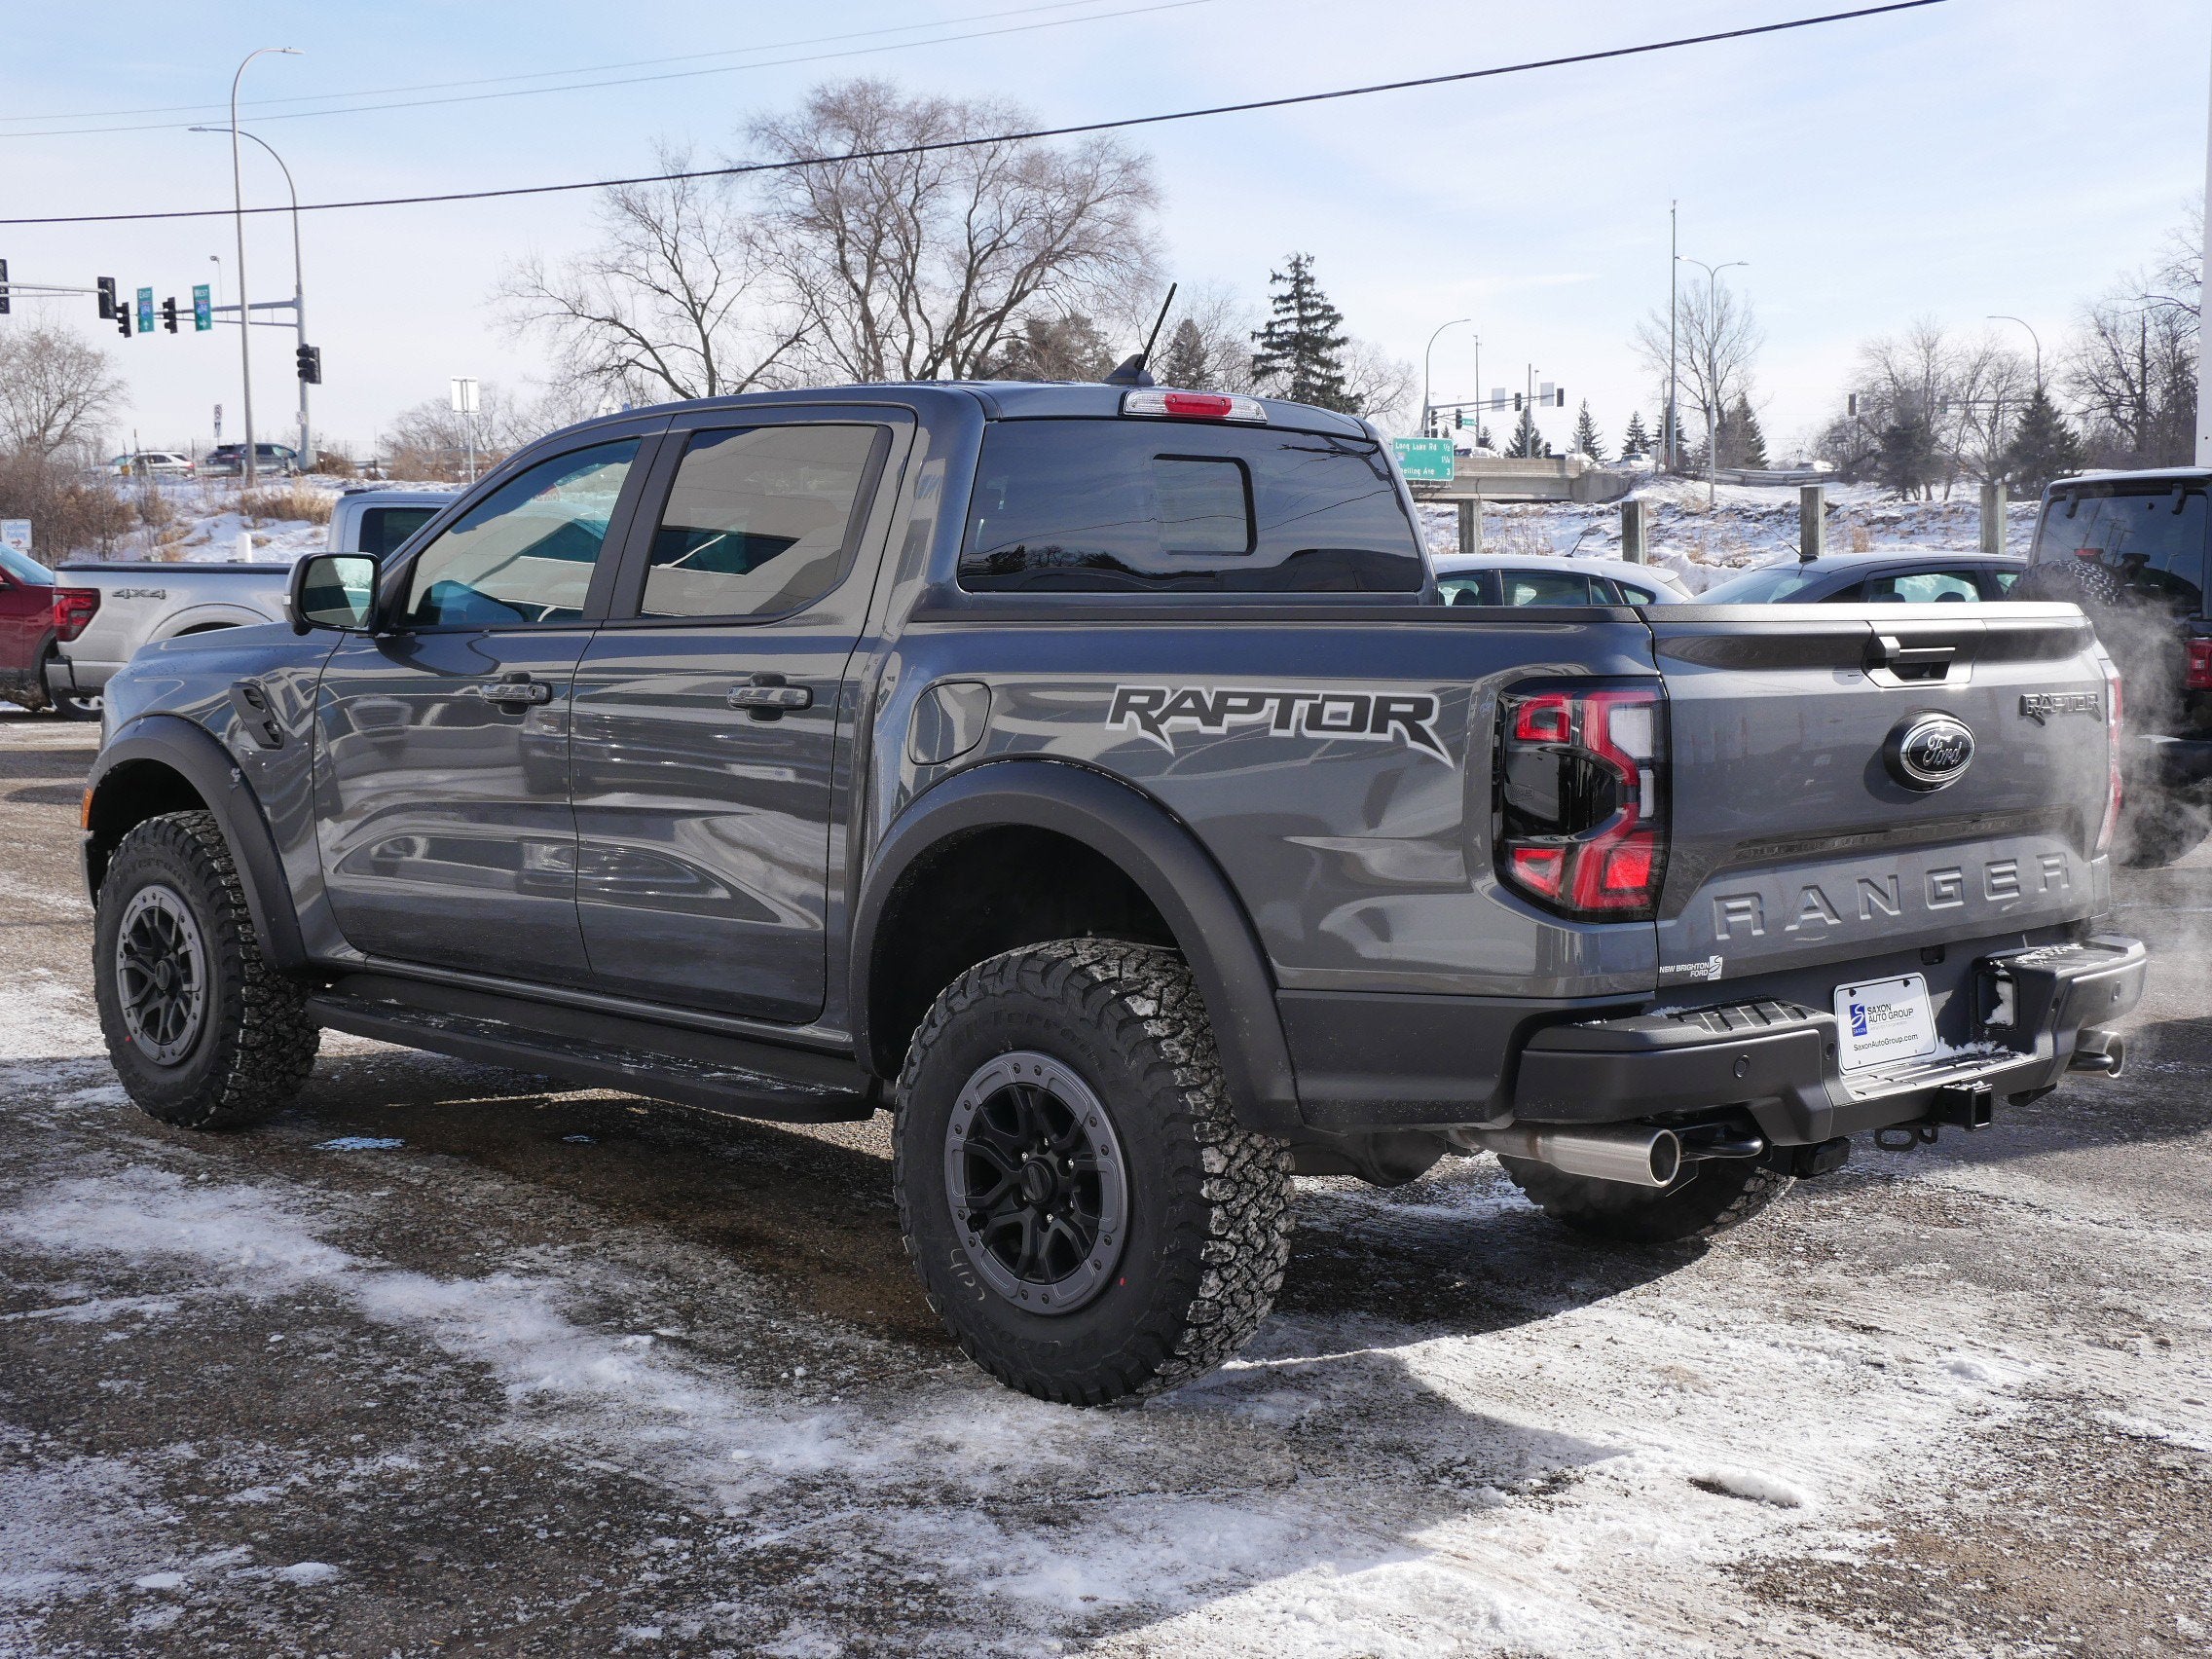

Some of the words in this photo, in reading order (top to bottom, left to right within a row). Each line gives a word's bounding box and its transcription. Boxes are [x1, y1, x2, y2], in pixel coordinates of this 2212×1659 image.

[1395, 442, 1410, 452] Long
[2019, 692, 2102, 726] RAPTOR
[1105, 684, 1456, 770] RAPTOR
[1922, 733, 1963, 767] Ford
[1713, 851, 2070, 940] RANGER
[1676, 962, 1710, 973] BRIGHTON
[1867, 1004, 1892, 1014] SAXON
[1868, 1013, 1887, 1023] AUTO
[1889, 1008, 1914, 1019] GROUP
[1854, 1034, 1919, 1051] SaxonAutoGroup.com
